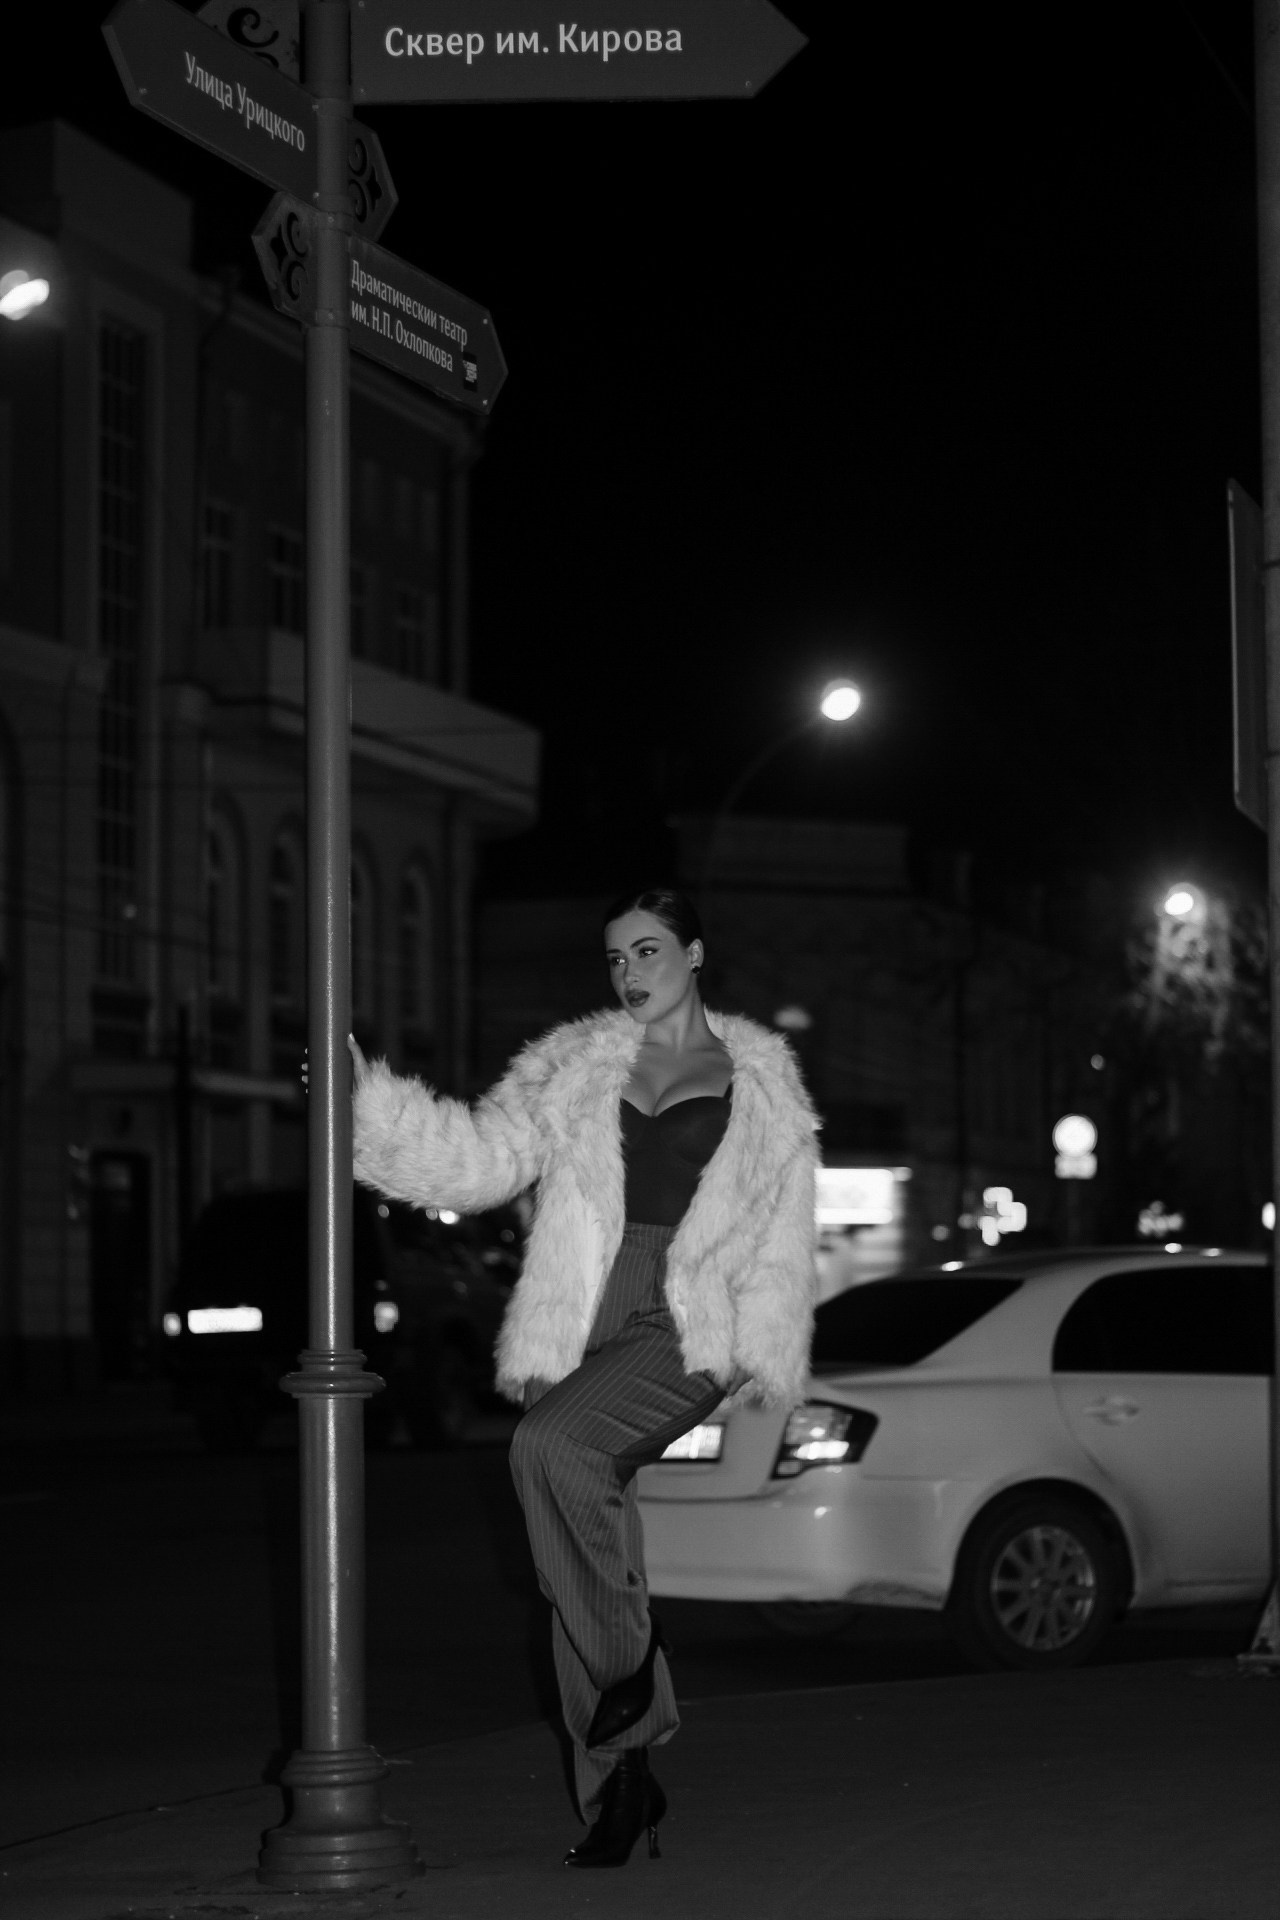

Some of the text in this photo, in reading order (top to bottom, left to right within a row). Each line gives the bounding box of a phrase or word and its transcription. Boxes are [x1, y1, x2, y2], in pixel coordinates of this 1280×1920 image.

[385, 23, 683, 65] Сквер им. Кирова
[185, 51, 305, 152] Улица Урицкого
[351, 300, 370, 327] им.
[372, 305, 394, 340] Н.П.
[395, 320, 453, 372] Охлопкова
[439, 315, 468, 352] театр
